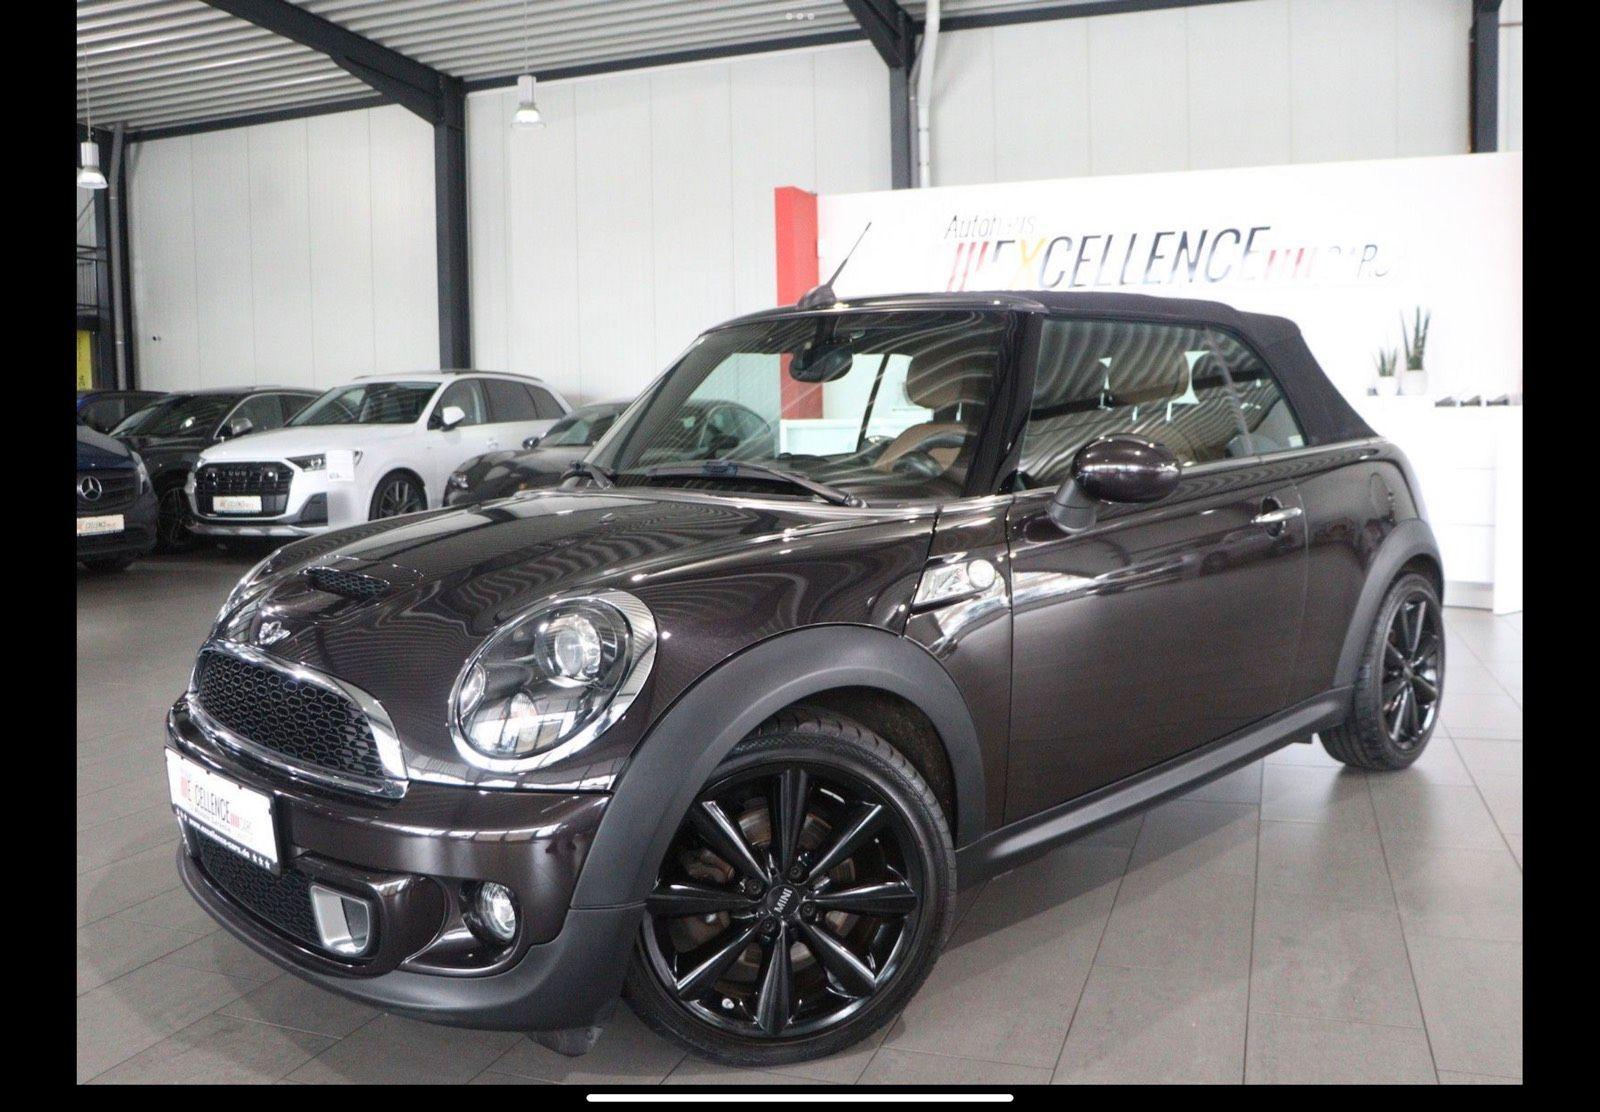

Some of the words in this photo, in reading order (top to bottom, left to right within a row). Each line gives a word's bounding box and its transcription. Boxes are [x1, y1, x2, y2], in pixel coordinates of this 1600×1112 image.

[943, 213, 1037, 240] Autohs
[187, 779, 231, 824] ECELLENCE
[773, 888, 793, 913] MINI
